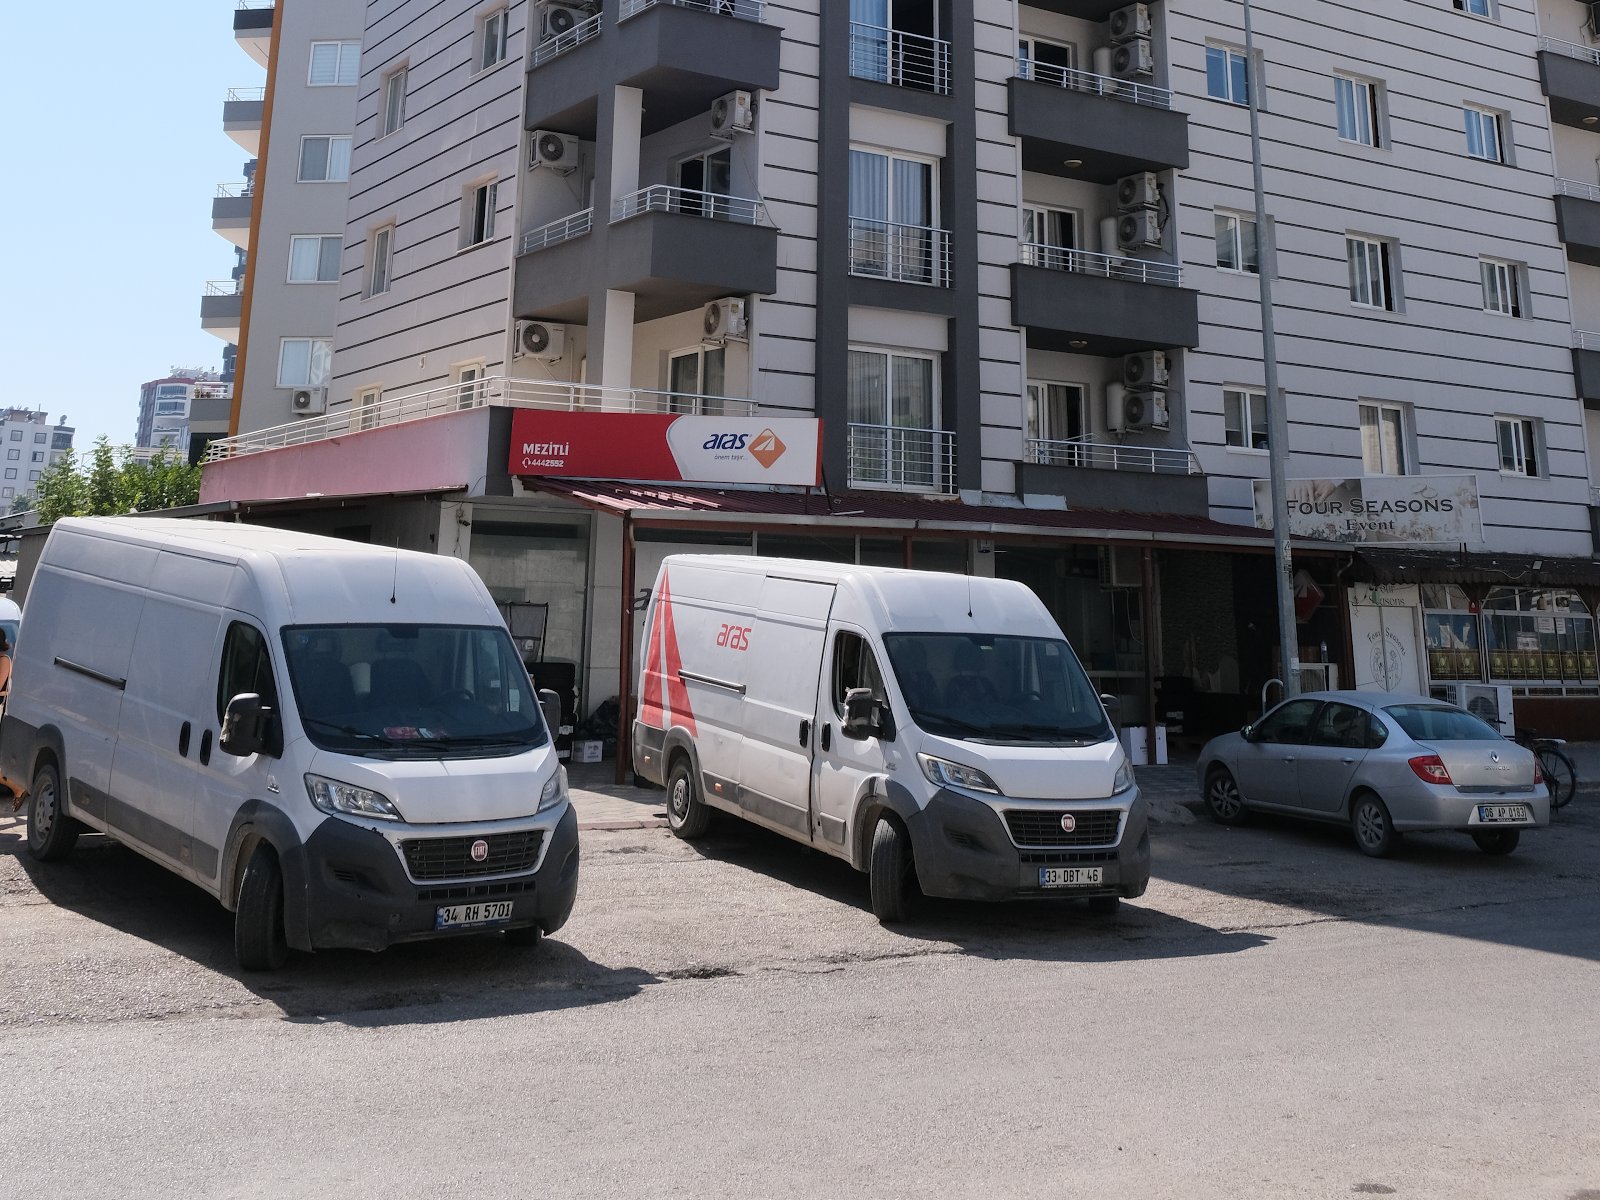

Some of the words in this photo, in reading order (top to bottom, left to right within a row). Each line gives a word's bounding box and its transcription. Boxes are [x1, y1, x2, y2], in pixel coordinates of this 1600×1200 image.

[522, 441, 570, 456] MEZİTLİ
[702, 433, 749, 450] aras
[1349, 498, 1454, 514] SEASONS
[1345, 519, 1396, 531] Event
[716, 623, 753, 651] aras
[1045, 870, 1057, 883] 33
[1063, 869, 1081, 883] DBT
[1087, 869, 1099, 882] 46
[443, 908, 458, 923] 34
[464, 906, 480, 921] RH
[483, 903, 511, 919] 5701
